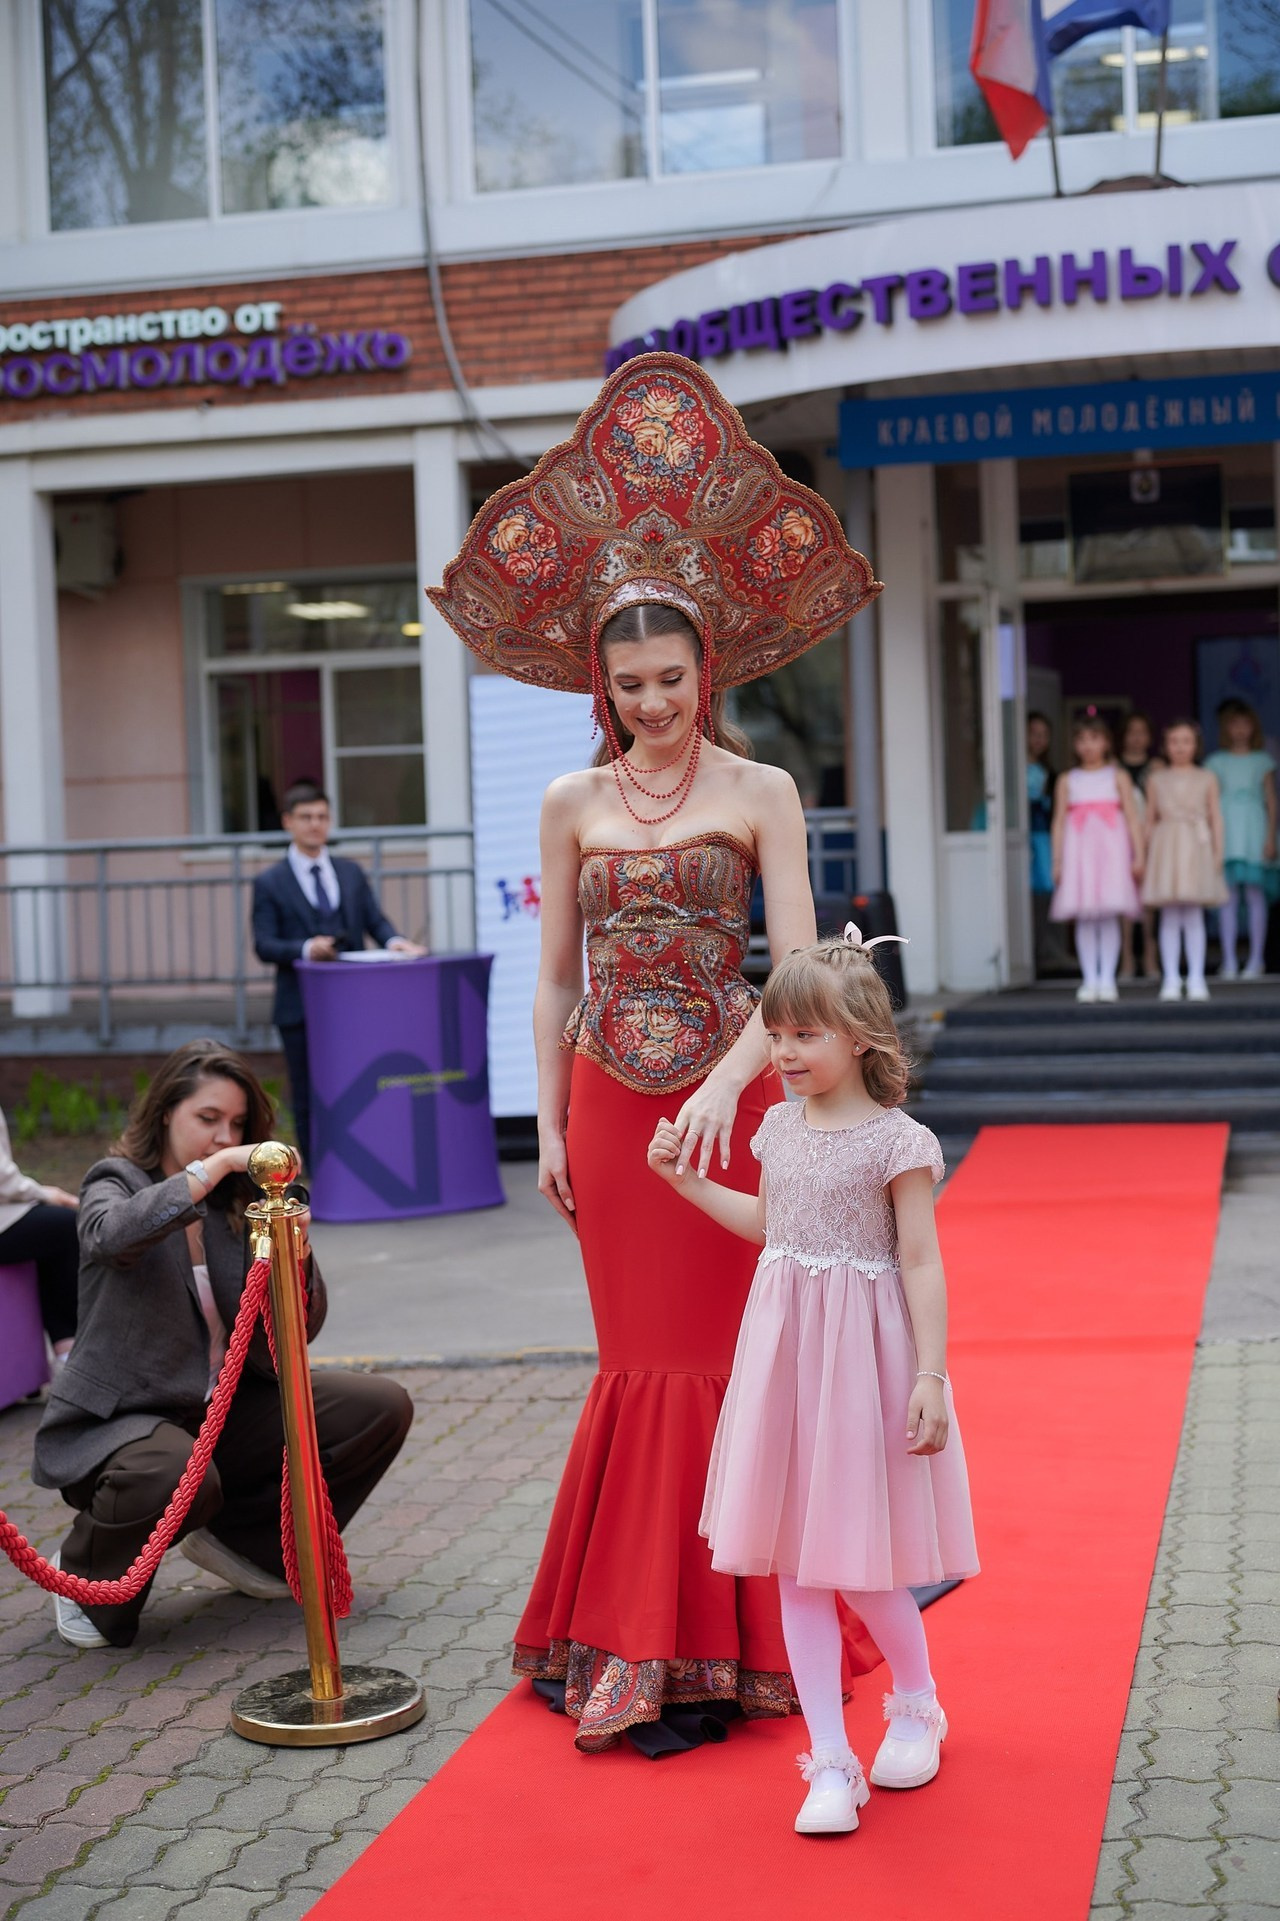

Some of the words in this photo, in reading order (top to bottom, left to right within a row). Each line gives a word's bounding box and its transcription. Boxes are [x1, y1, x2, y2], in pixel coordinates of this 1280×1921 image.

[233, 302, 282, 334] от
[666, 239, 1241, 357] ОБЩЕСТВЕННЫХ
[0, 323, 412, 398] осмолодёжь
[877, 403, 1014, 446] КРАЕВОЙ
[1032, 387, 1256, 436] МОЛОДЁЖНЫЙ
